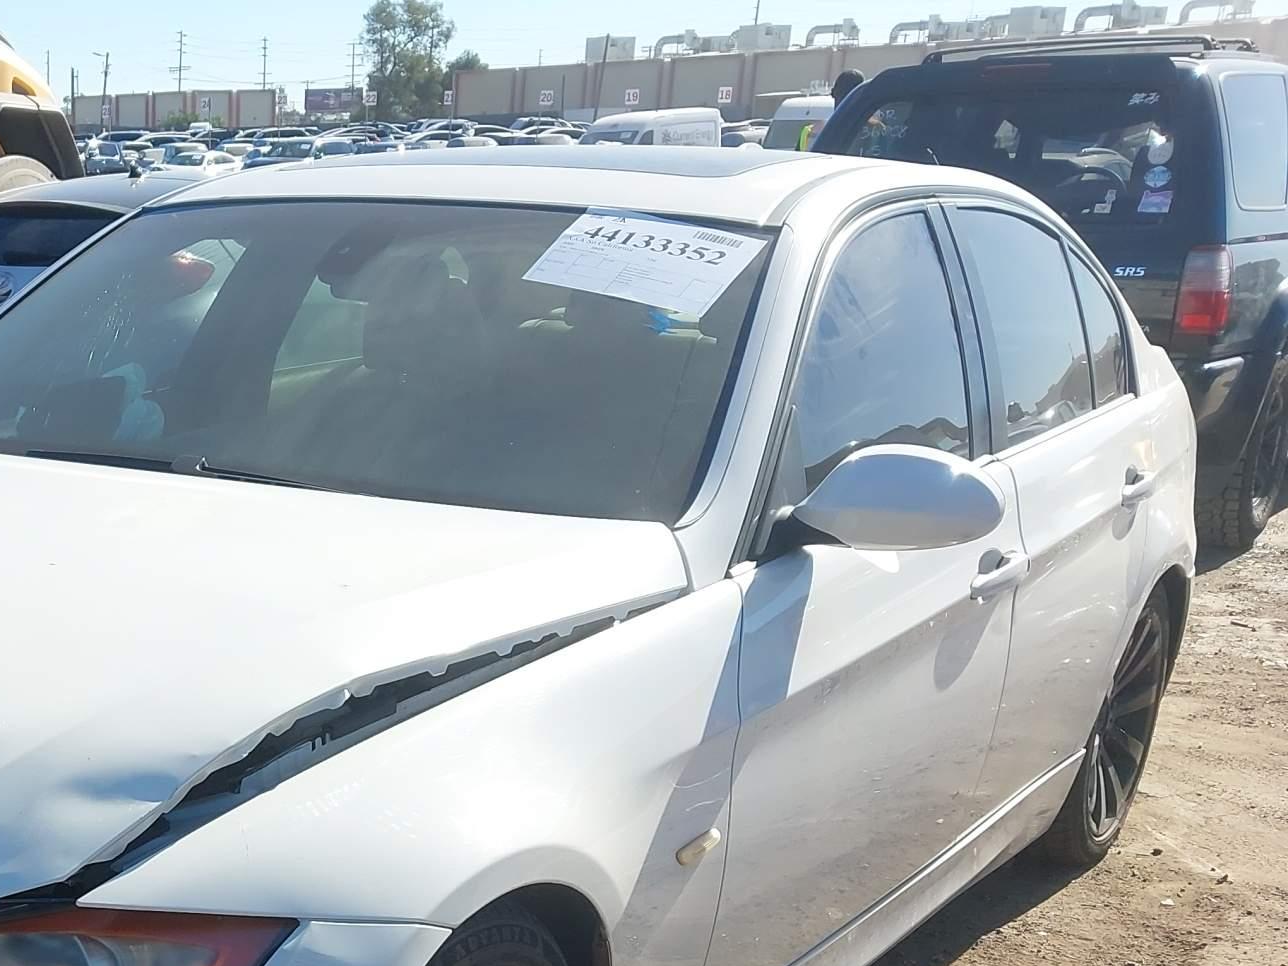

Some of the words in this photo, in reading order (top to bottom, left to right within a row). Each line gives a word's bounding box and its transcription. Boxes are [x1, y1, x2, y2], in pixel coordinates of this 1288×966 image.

[366, 94, 376, 104] 22
[540, 92, 552, 102] 20
[626, 91, 638, 102] 19
[719, 89, 731, 100] 18
[277, 95, 287, 105] 23
[583, 226, 727, 266] 44133352
